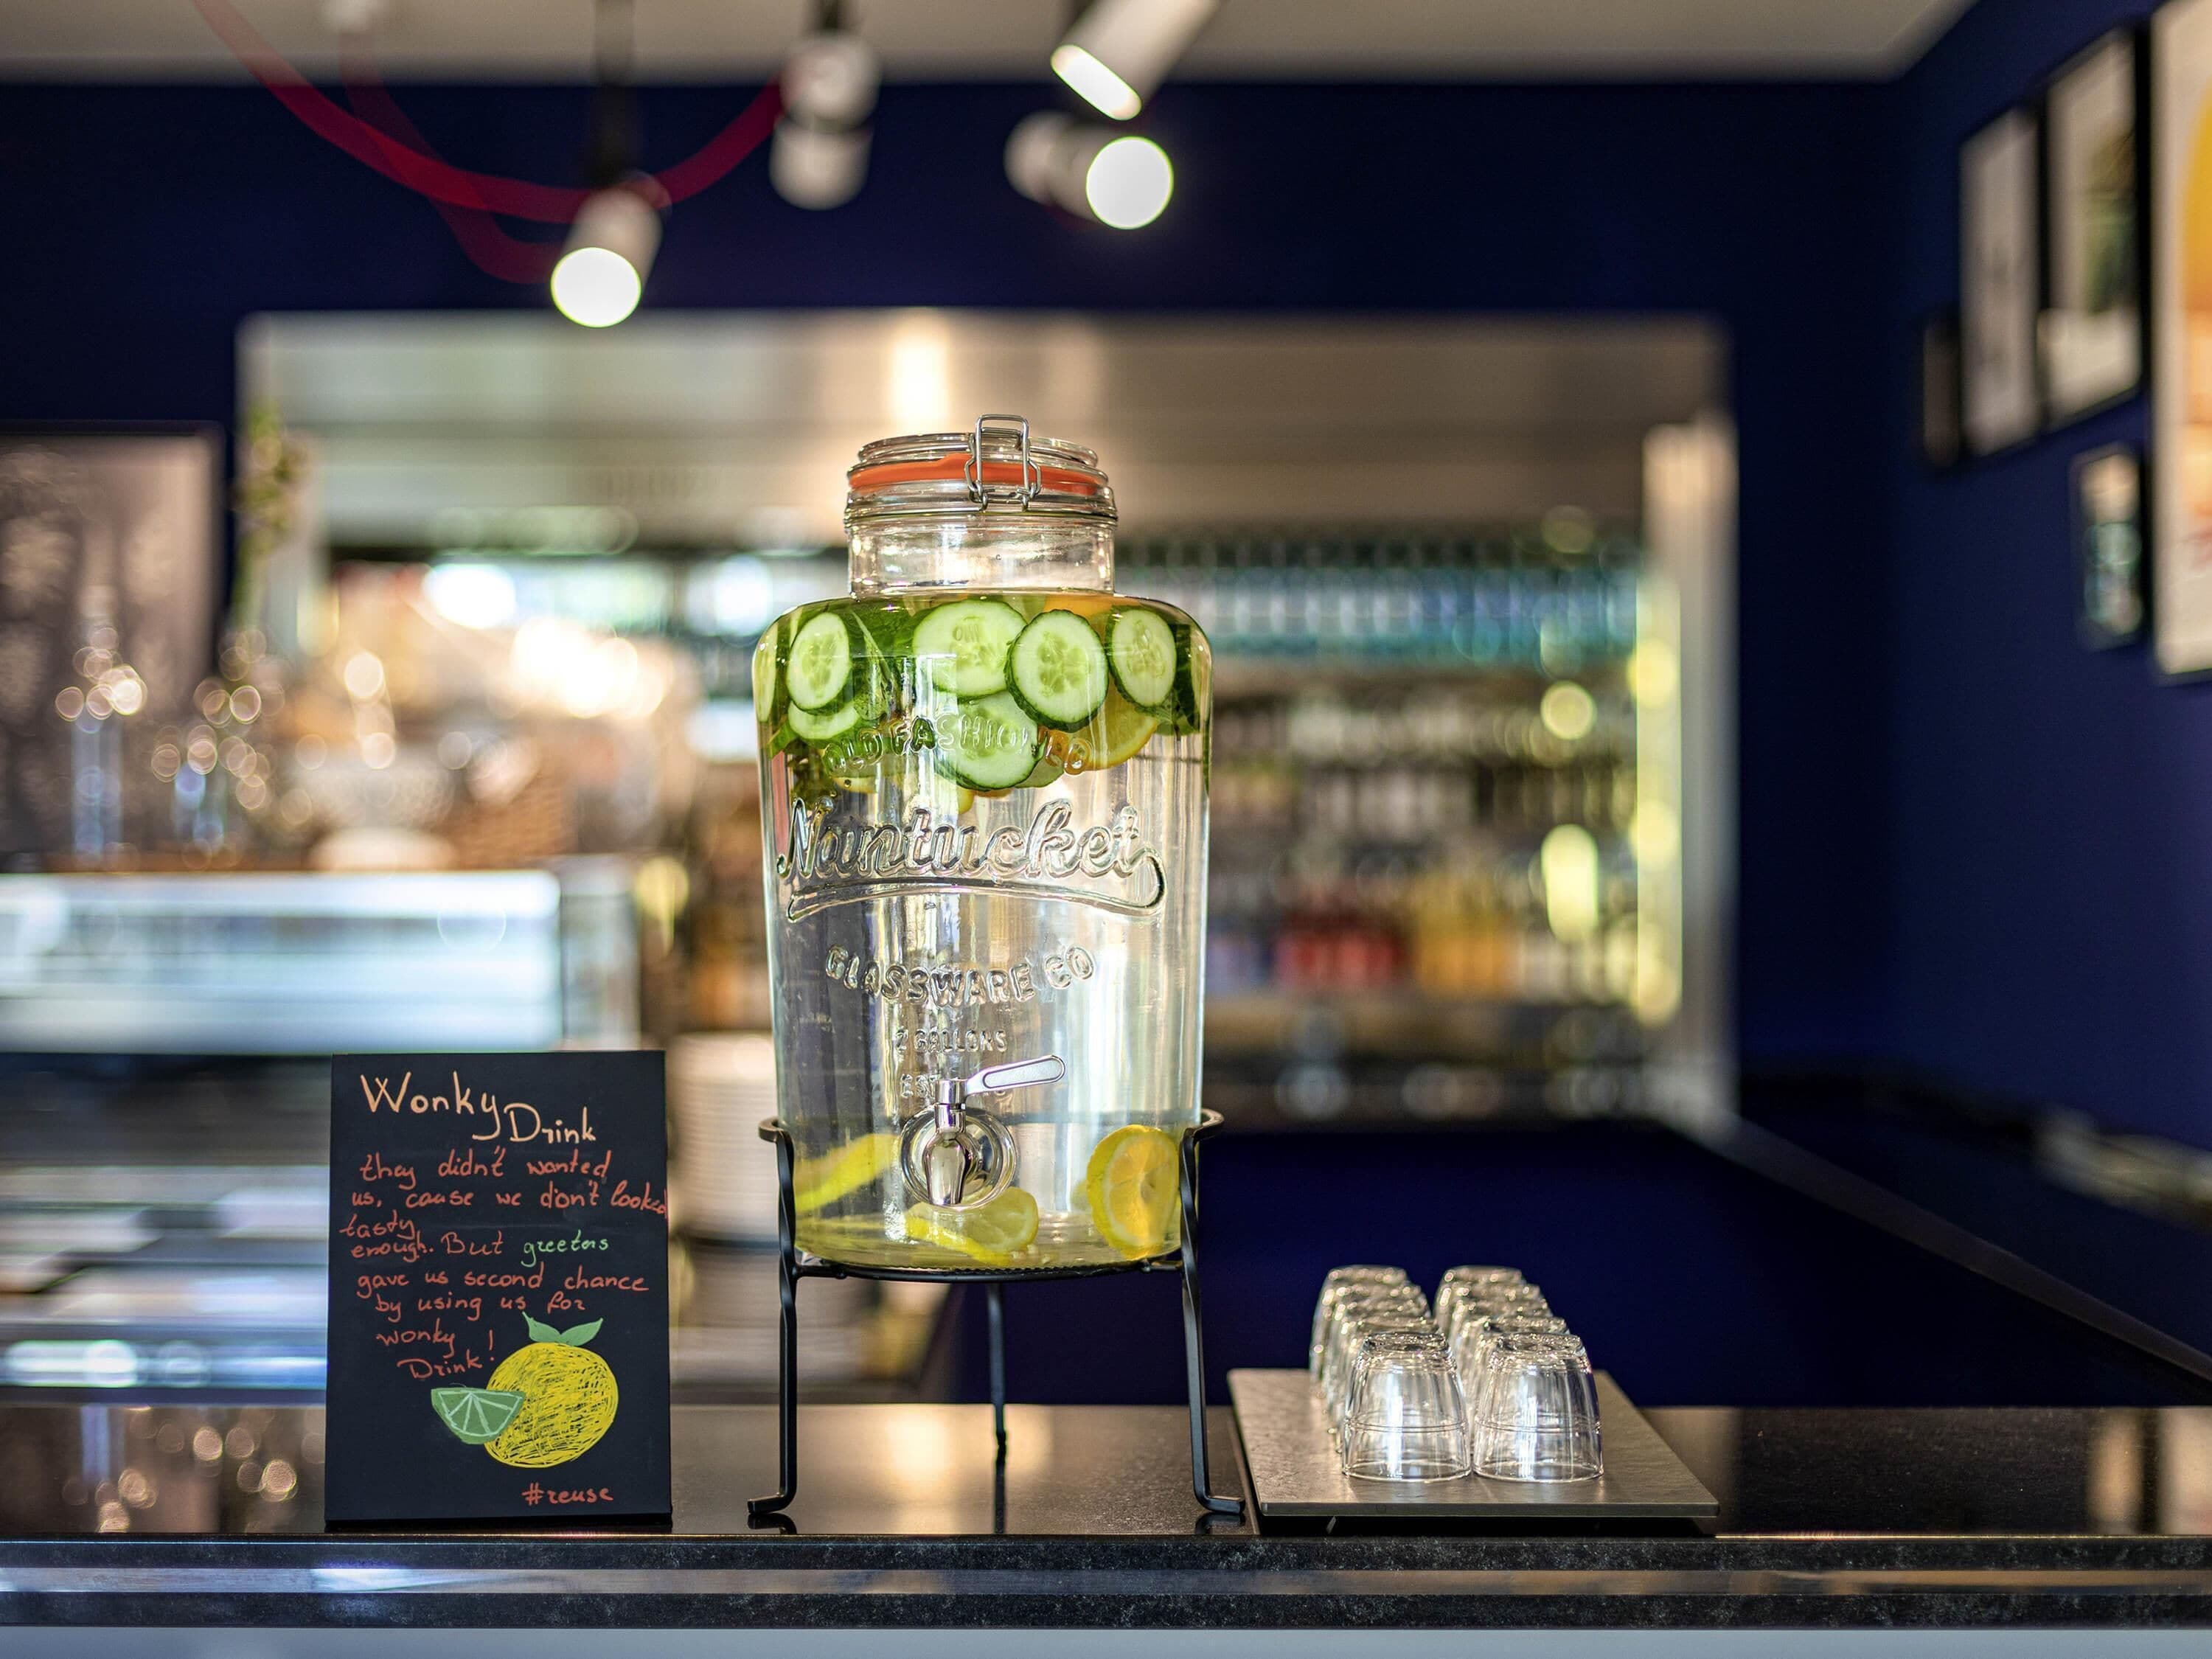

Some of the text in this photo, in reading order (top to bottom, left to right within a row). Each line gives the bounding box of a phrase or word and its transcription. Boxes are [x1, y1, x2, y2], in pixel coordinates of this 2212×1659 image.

[821, 728, 884, 773] OLD
[776, 796, 1150, 882] Nantucket
[825, 944, 1096, 1008] GLASSWARE CO
[914, 1026, 1008, 1054] GALLONS
[360, 1071, 501, 1141] Wonky
[503, 1102, 597, 1144] Drink
[359, 1144, 612, 1190] they didn't wanted
[352, 1192, 382, 1208] us,
[406, 1190, 473, 1208] cause
[495, 1192, 521, 1206] we
[540, 1179, 599, 1208] don't
[339, 1209, 416, 1240] tasty
[351, 1231, 434, 1263] enough.
[440, 1231, 504, 1256] But
[356, 1261, 650, 1299] gave us second chance
[375, 1290, 585, 1323] by using us for
[376, 1318, 455, 1359] wonky
[521, 1482, 614, 1506] #reuse
